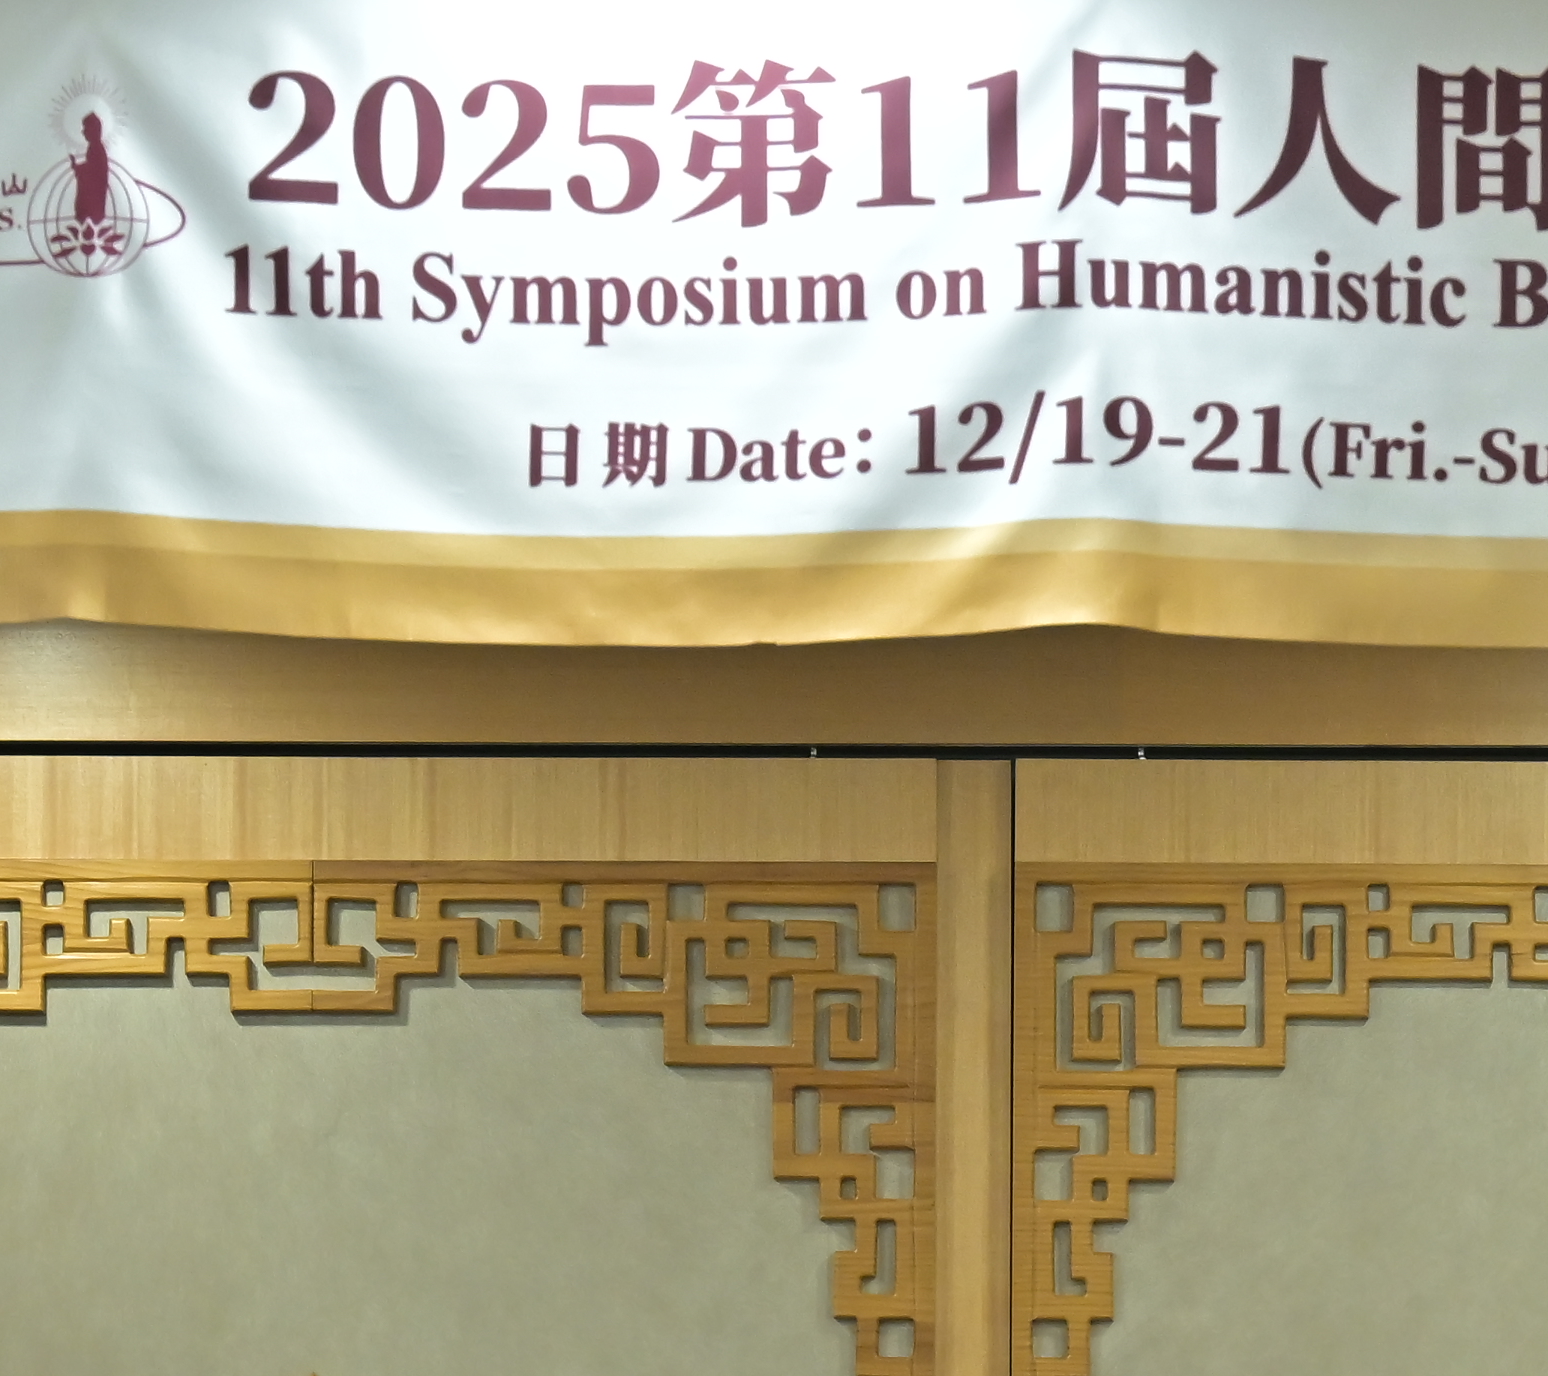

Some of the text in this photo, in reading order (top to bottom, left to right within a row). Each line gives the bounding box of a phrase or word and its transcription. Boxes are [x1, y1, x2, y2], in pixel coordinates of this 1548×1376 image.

[225, 244, 382, 320] 11th
[412, 253, 867, 347] Symposium
[896, 268, 986, 320] on
[1017, 241, 1466, 328] Humanistic
